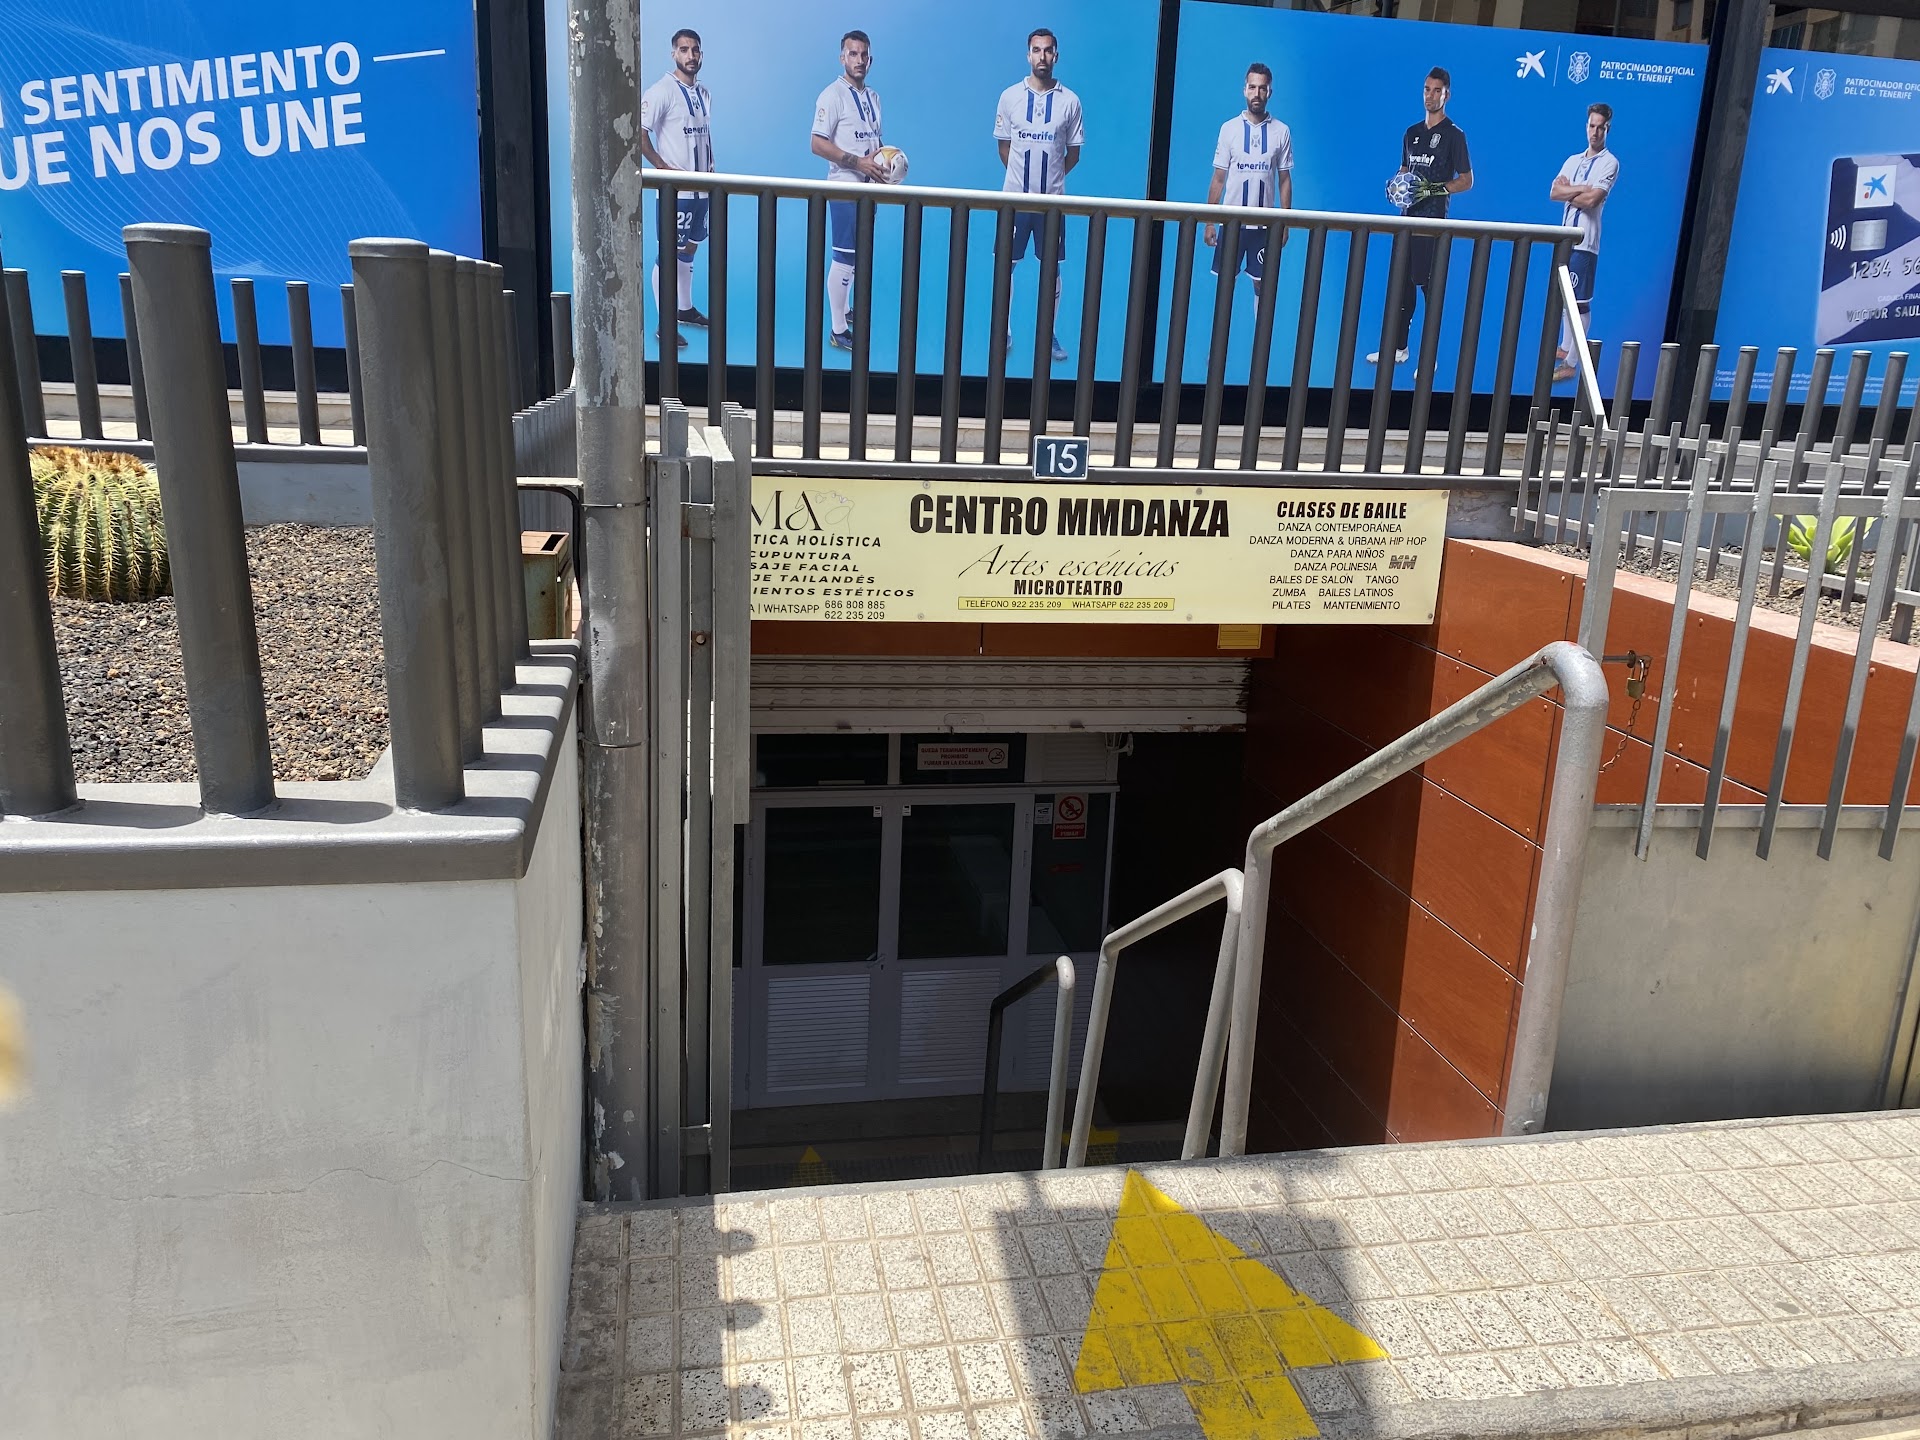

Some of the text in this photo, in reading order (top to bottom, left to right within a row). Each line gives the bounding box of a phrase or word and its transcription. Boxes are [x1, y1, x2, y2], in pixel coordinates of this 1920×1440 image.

[1601, 61, 1695, 76] PATROCINADOR OFICIAL
[1600, 70, 1615, 79] DEL
[1616, 72, 1624, 80] C.
[1637, 73, 1673, 84] TENERIFE
[20, 41, 361, 126] SENTIMIENTO
[1845, 78, 1903, 90] PATROCINADOR
[1844, 87, 1857, 95] DEL
[1860, 88, 1867, 96] C.
[1879, 90, 1912, 99] TENERIFE
[89, 111, 222, 178] NOS
[240, 92, 366, 158] UNE
[1850, 259, 1891, 279] 1234
[1047, 443, 1078, 473] 15
[910, 494, 1230, 537] CENTRO MMDANZA
[1277, 501, 1407, 519] CLASES DE BAILE
[1278, 521, 1402, 533] DANZA CONTEMPORÁNEA
[797, 533, 881, 548] HOLÍSTICA
[1249, 536, 1427, 545] DANZA MODERNA & URBANA HIP HOP
[1290, 547, 1385, 558] DANZA PARA NIÑOS
[958, 543, 1180, 579] Artes escénicas
[1294, 563, 1378, 571] DANZA POLINESIA
[799, 563, 860, 572] FACIAL
[780, 574, 875, 584] TAILANDÉS
[1269, 574, 1399, 584] BAILES DE SALÓN TANGO
[823, 587, 914, 597] ESTÉTICOS
[1013, 579, 1123, 596] MICROTEATRO
[1272, 588, 1394, 597] ZUMBA BAILES LATINOS
[764, 604, 819, 613] WHATSAPP
[824, 601, 885, 609] 686 808 885
[965, 598, 1168, 609] TELÉFONO 922 235 209 WHATSAPP 622 235 209
[1272, 601, 1401, 610] PILATES MANTENIMIENTO
[824, 611, 885, 620] 622 235 209
